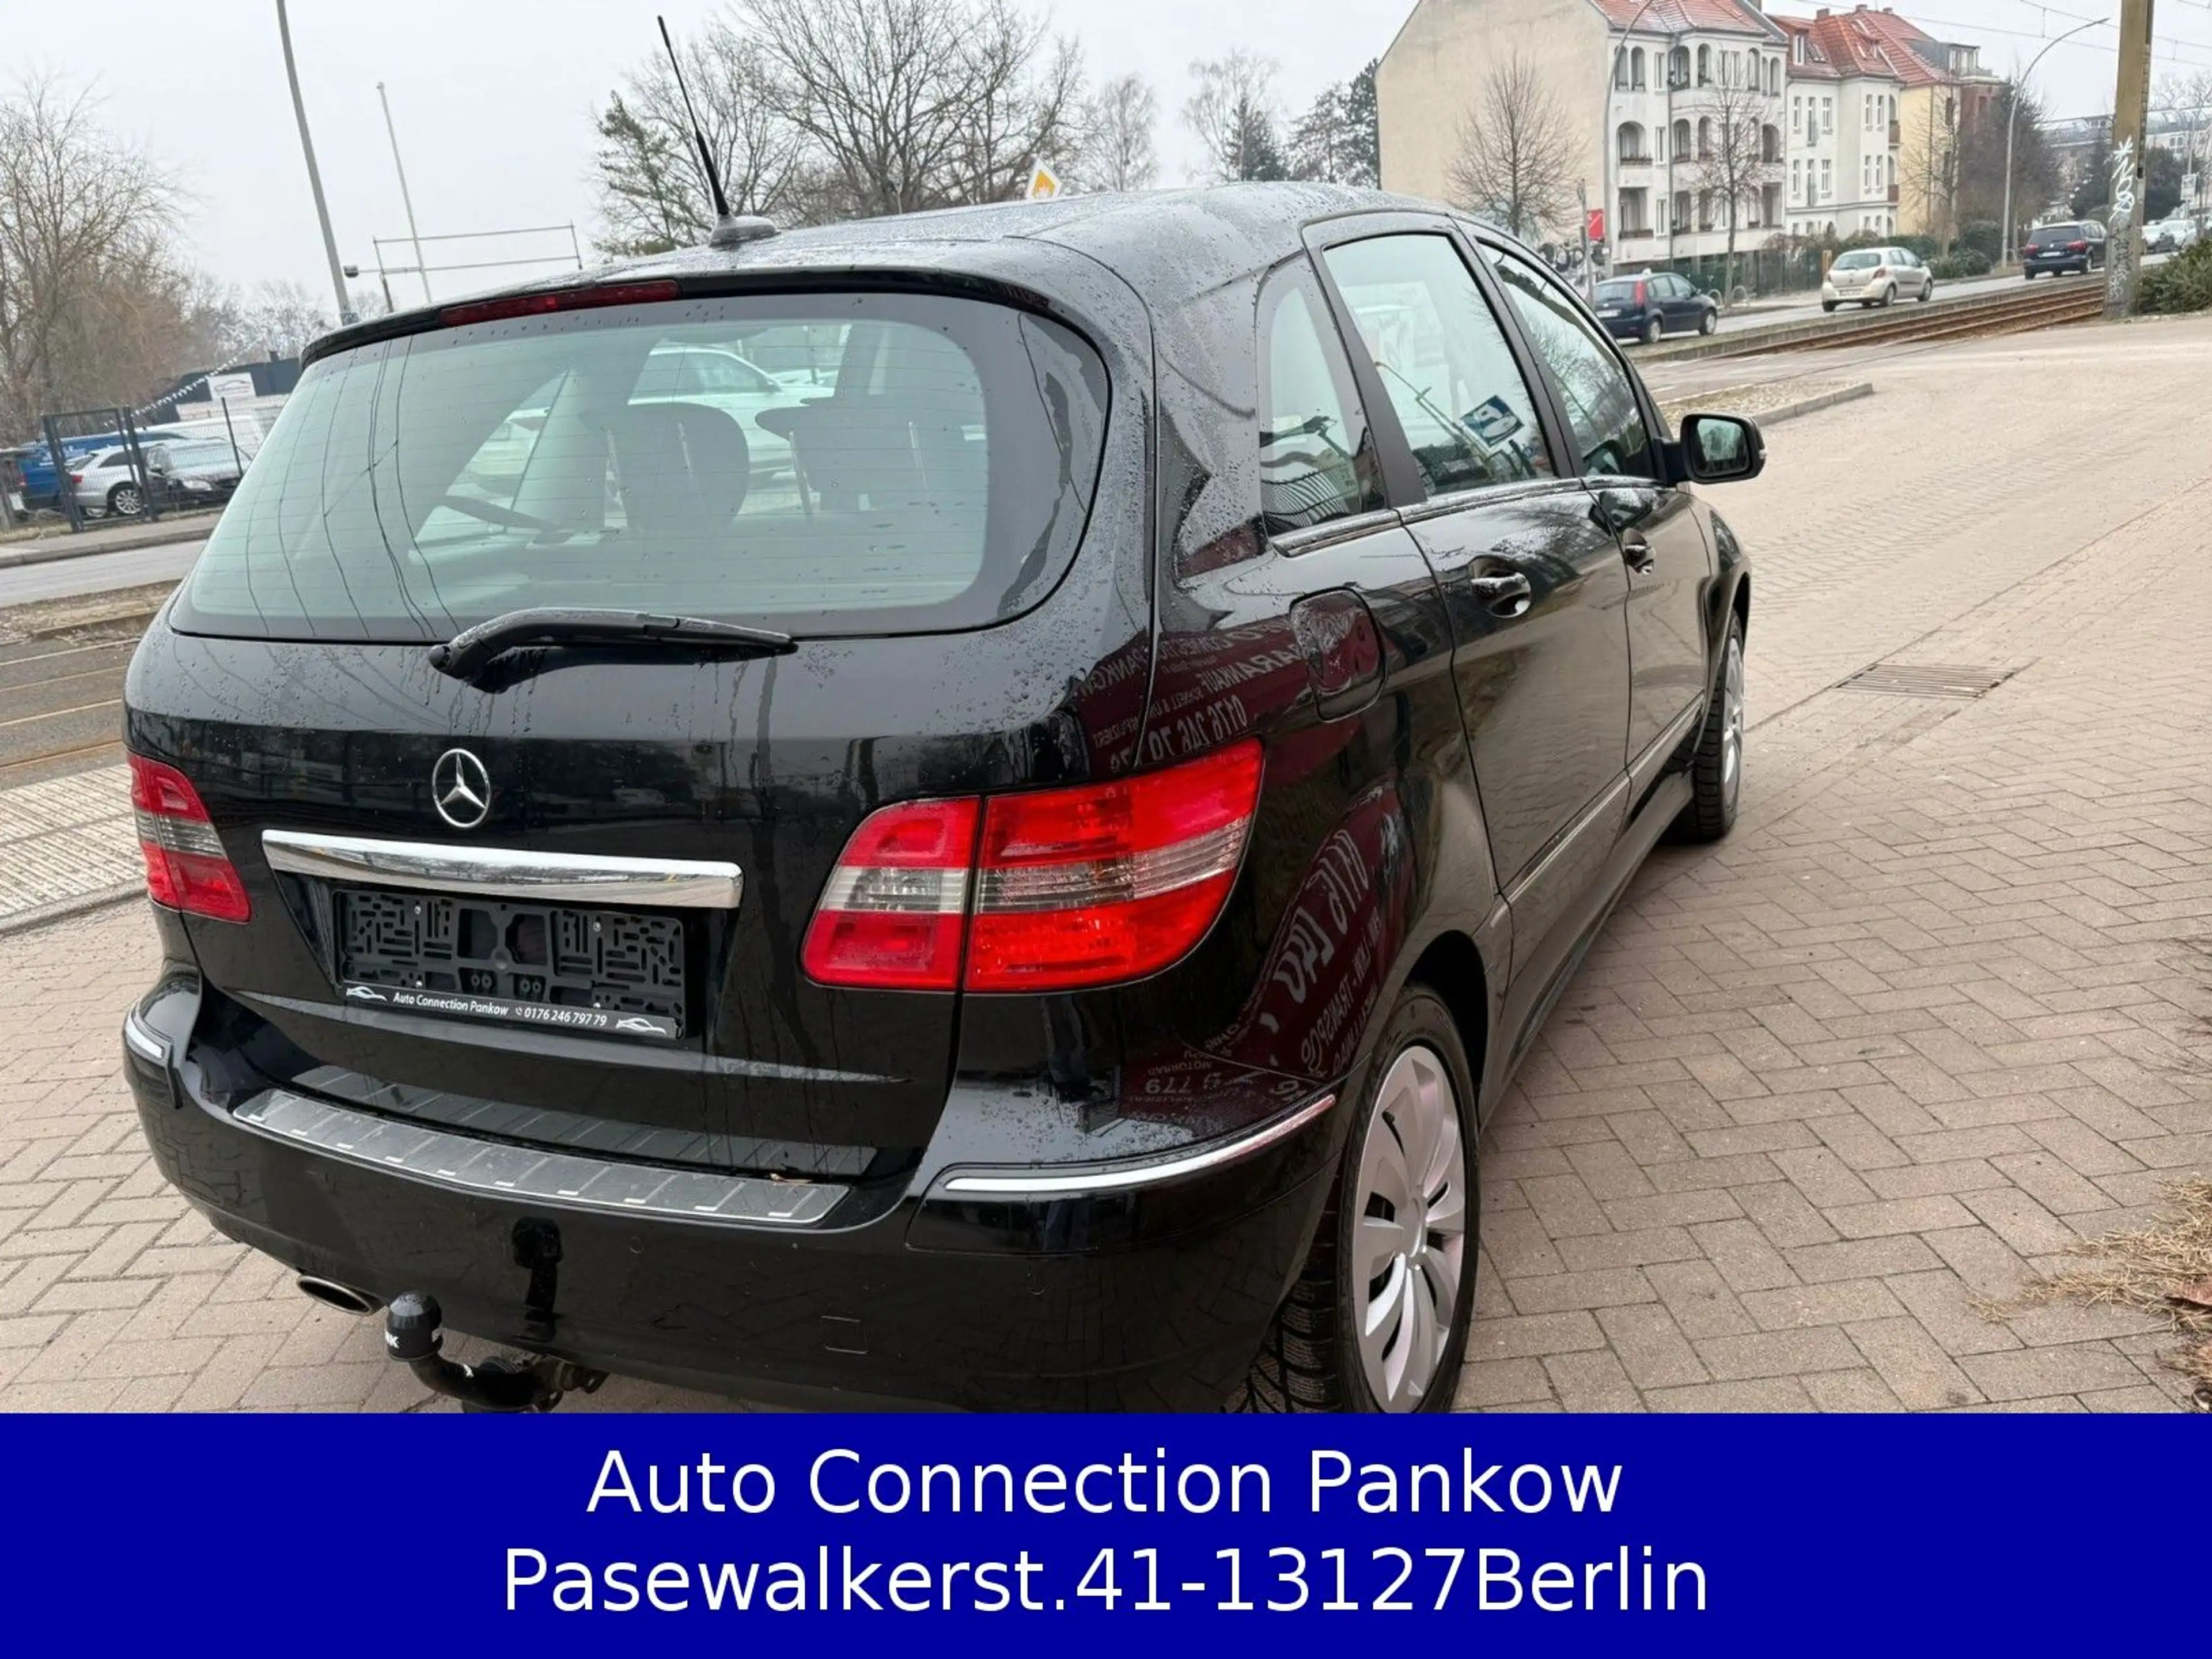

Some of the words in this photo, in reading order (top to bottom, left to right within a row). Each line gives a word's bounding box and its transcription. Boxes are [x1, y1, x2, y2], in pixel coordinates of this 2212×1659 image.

[393, 992, 415, 1005] Auto
[415, 994, 468, 1012] Connection
[469, 1001, 509, 1016] Pankow
[524, 1007, 550, 1020] 0176
[551, 1010, 571, 1023] 246
[571, 1012, 592, 1025] 797
[593, 1014, 608, 1027] 79
